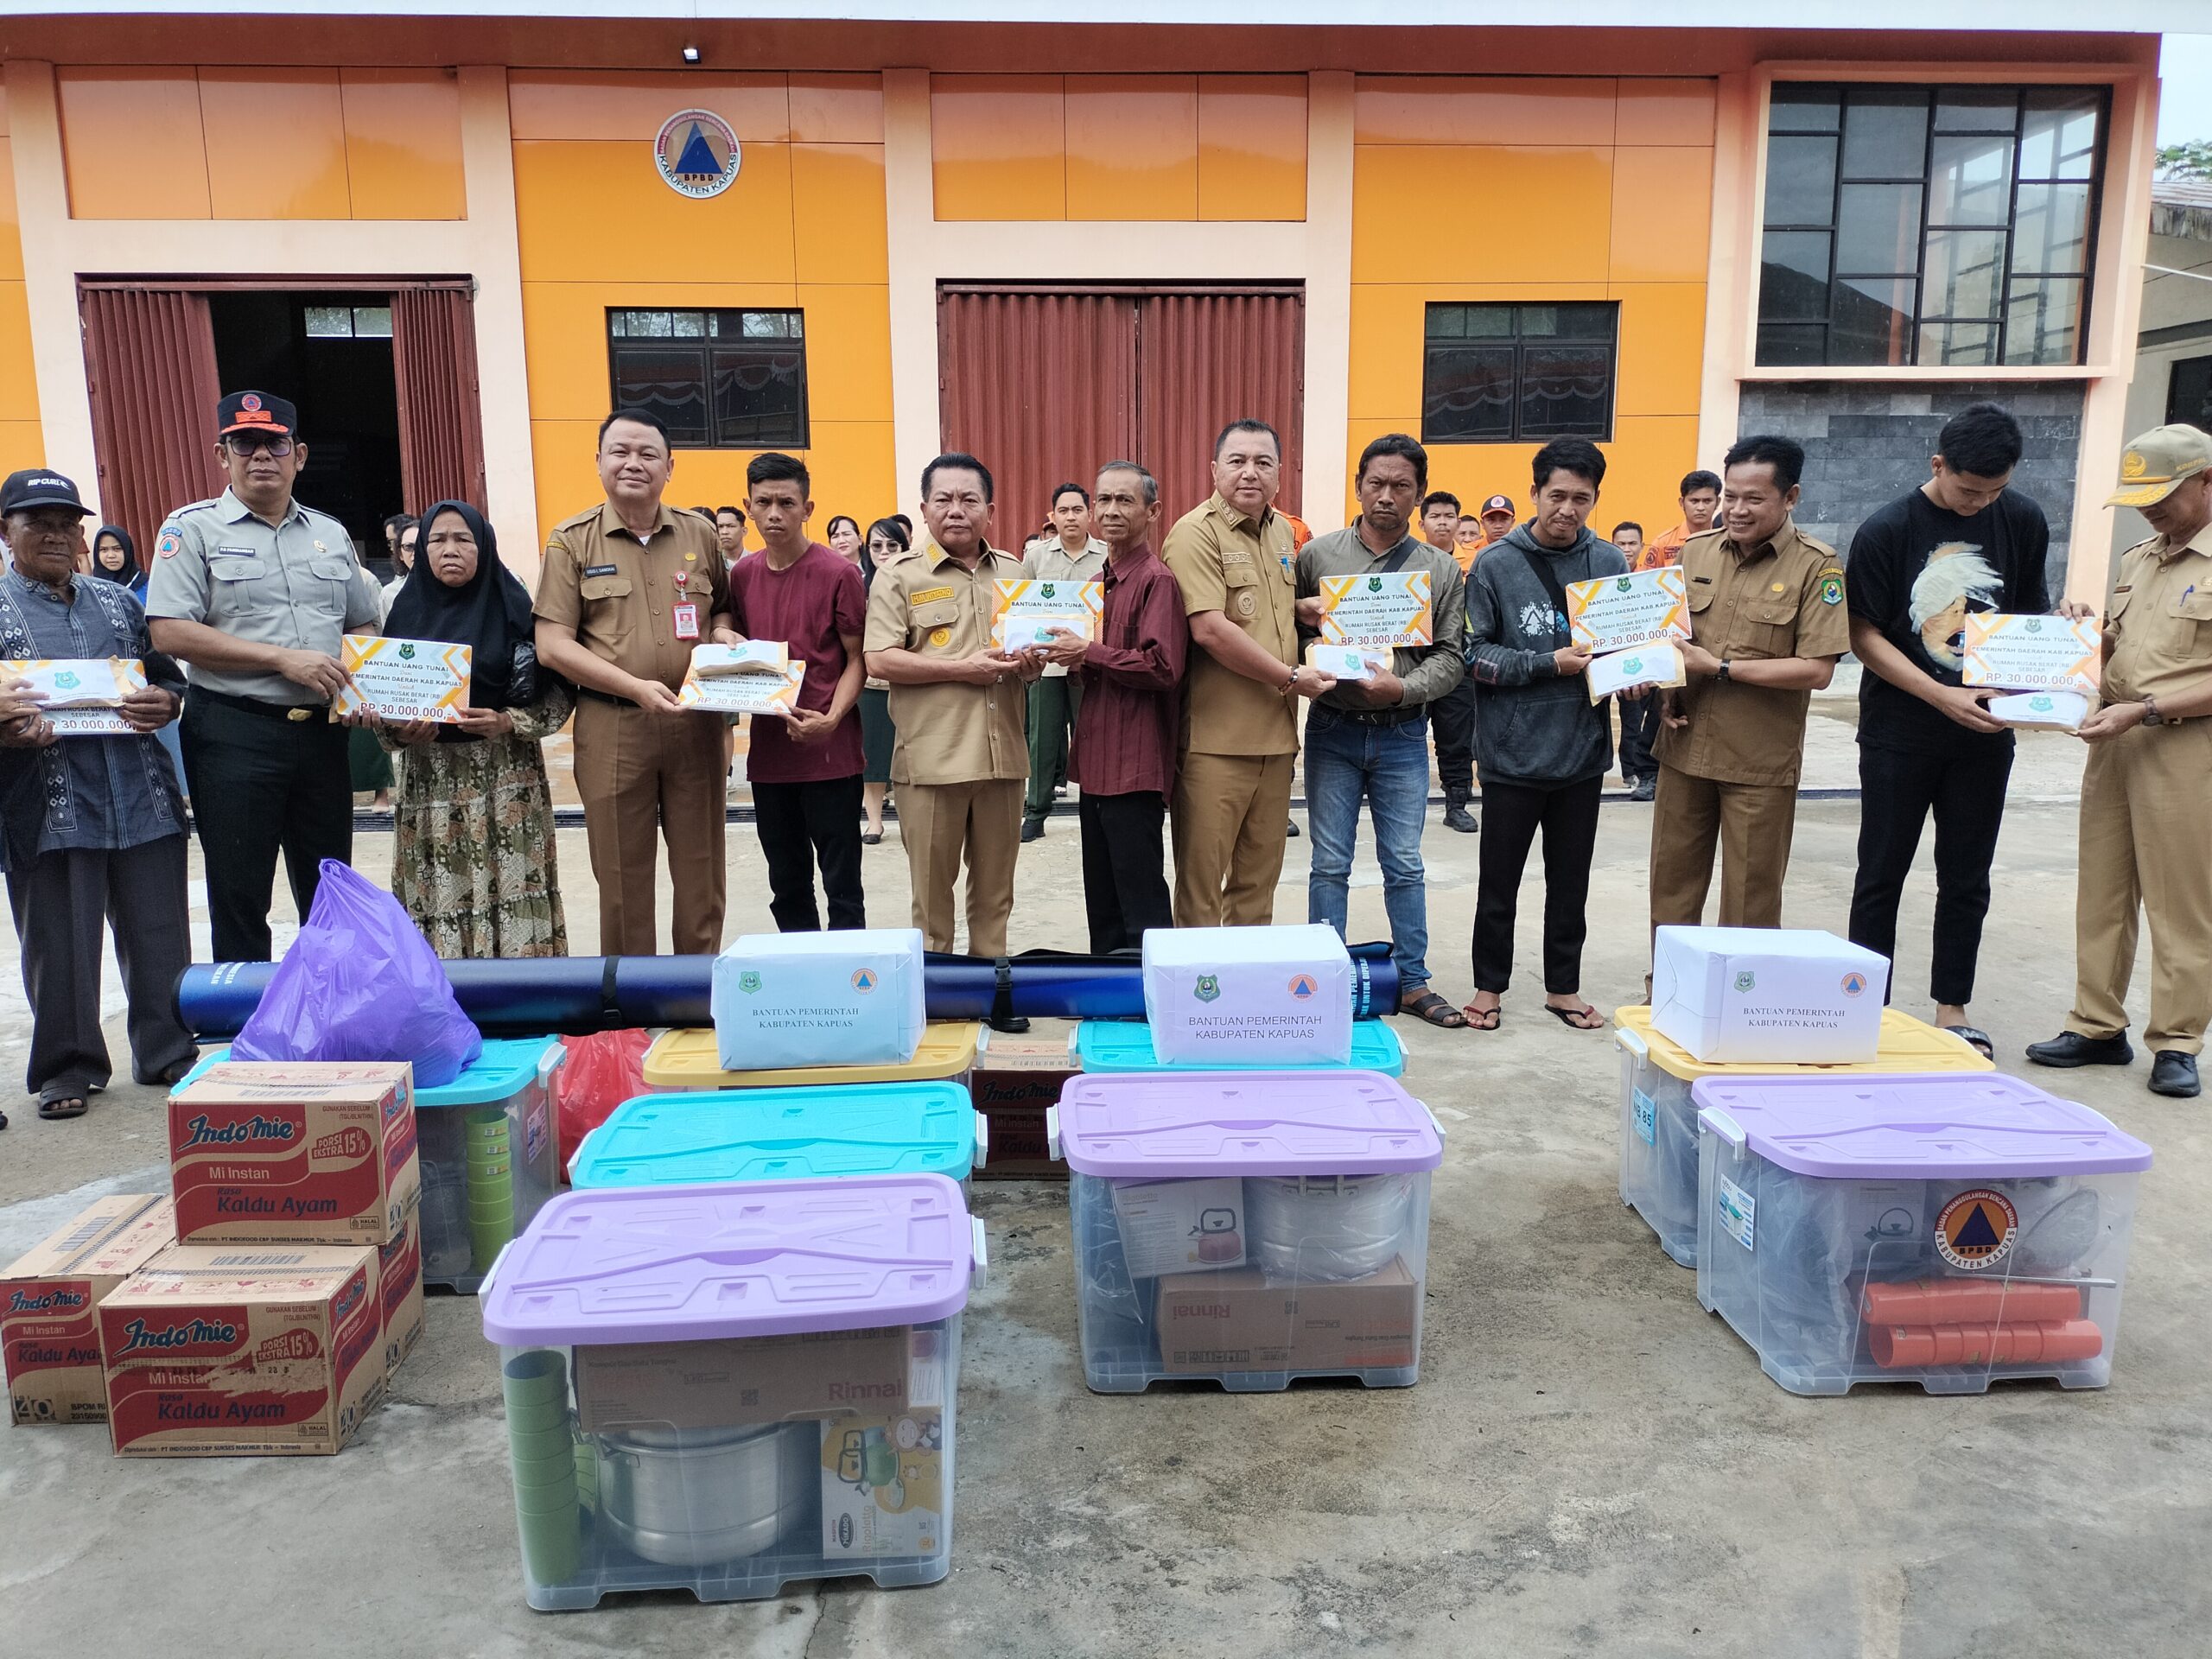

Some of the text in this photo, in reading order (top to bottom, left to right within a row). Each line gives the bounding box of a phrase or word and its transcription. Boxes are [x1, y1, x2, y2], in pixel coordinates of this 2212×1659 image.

[659, 154, 737, 194] KABUPATEN KAPUAS
[27, 478, 41, 486] RIP
[1587, 597, 1620, 607] BANTUAN
[1643, 589, 1665, 598] TUNAI
[1575, 611, 1614, 620] PEMERINTAH
[1641, 601, 1681, 611] KAB.KAPUAS
[1341, 633, 1418, 645] RP. 30.000.000,-
[1592, 628, 1675, 649] RP. 30.000.000,-
[426, 664, 448, 672] TUNAI
[352, 673, 390, 682] EMERINTAH
[420, 677, 462, 687] KAB.KAPUAS
[1986, 673, 2082, 686] RP. 30.000.000,-
[380, 704, 453, 719] 30.000.000,-
[1743, 1007, 1784, 1016] BANTUAN
[1189, 1015, 1322, 1026] BANTUAN PEMERINTAH
[1748, 1020, 1838, 1029] KABUPATEN KAPUAS
[1196, 1029, 1314, 1039] KABUPATEN KAPUAS
[1633, 1101, 1652, 1127] NB 85
[318, 1133, 342, 1148] PORSI
[344, 1128, 366, 1154] 15%
[314, 1145, 344, 1158] EKSTRA
[209, 1166, 270, 1179] Mi Instan
[218, 1187, 242, 1196] Rasa
[218, 1197, 338, 1217] Kaldu Ayam
[1946, 1192, 1988, 1216] PENANGGULANGAN
[1988, 1193, 2009, 1210] BENCANA
[1936, 1230, 2015, 1268] KABUPATEN KAPUAS
[1173, 1305, 1230, 1319] Rinnai
[22, 1326, 66, 1335] Mi Instan
[263, 1336, 288, 1351] PORSI
[290, 1330, 313, 1357] 15%
[18, 1348, 63, 1363] Kaldu
[258, 1347, 290, 1361] EKSTRA
[149, 1372, 213, 1384] Mi Insta
[829, 1379, 902, 1401] Rinnai
[158, 1393, 183, 1402] Rasa
[158, 1401, 285, 1423] Kaldu Ayam
[842, 1516, 850, 1545] MIKADO
